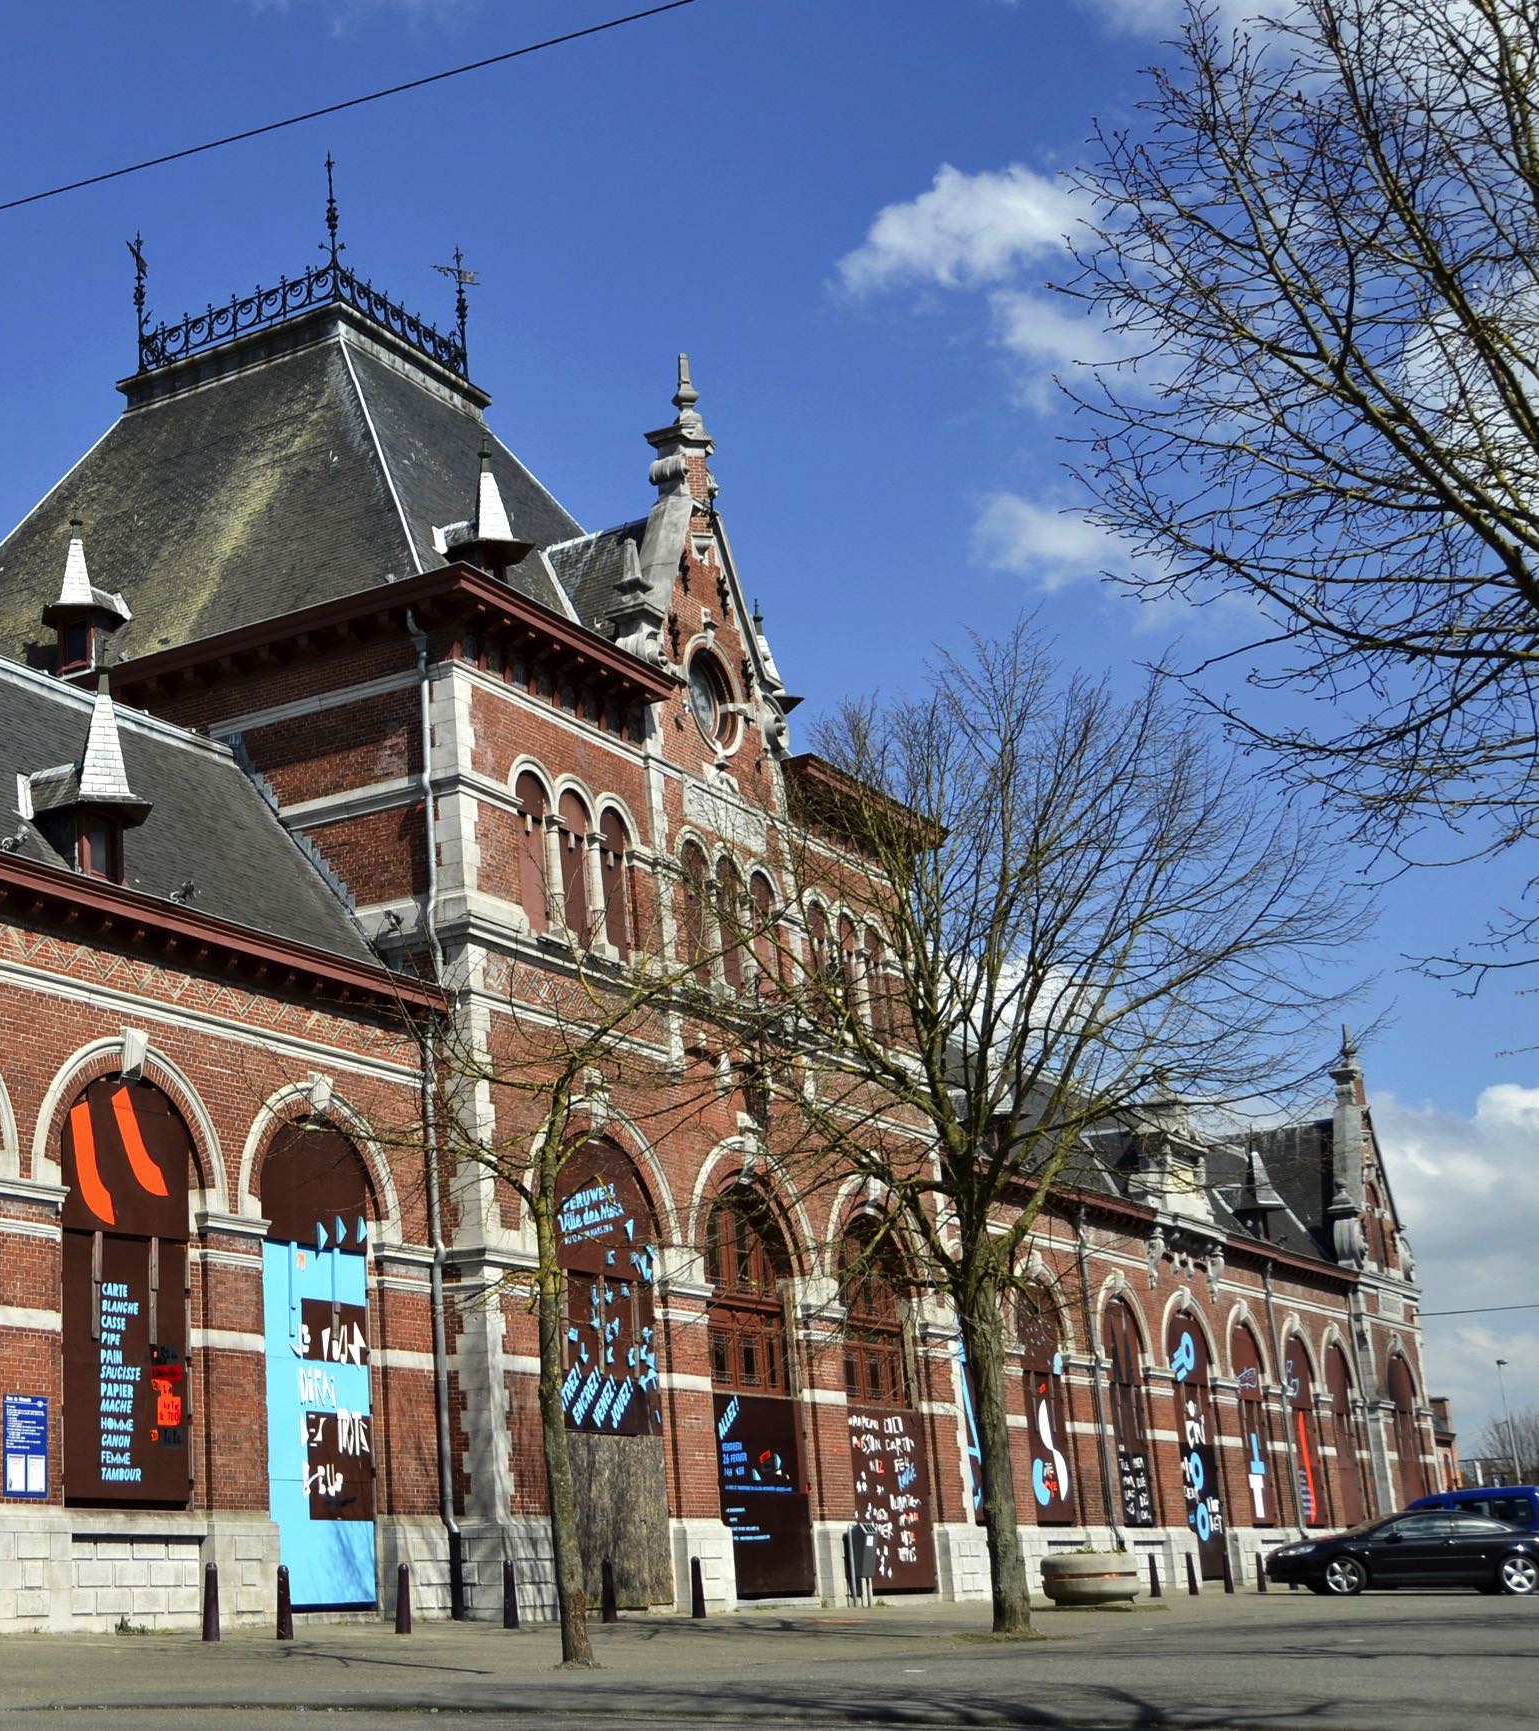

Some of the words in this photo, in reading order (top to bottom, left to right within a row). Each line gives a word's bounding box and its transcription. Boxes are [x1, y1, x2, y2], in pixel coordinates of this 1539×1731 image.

[102, 1282, 128, 1298] CARTE
[102, 1299, 139, 1315] BLANCHE
[101, 1315, 126, 1330] CASSE
[101, 1331, 121, 1346] PIPE
[100, 1349, 122, 1364] PAIN
[100, 1365, 141, 1381] SAUCISSE
[100, 1382, 134, 1398] PAPIER
[100, 1399, 133, 1413] MACHE
[101, 1416, 134, 1431] HOMME
[101, 1433, 131, 1448] CANON
[101, 1450, 131, 1465] FEMME
[101, 1467, 142, 1482] TAMBOUR
